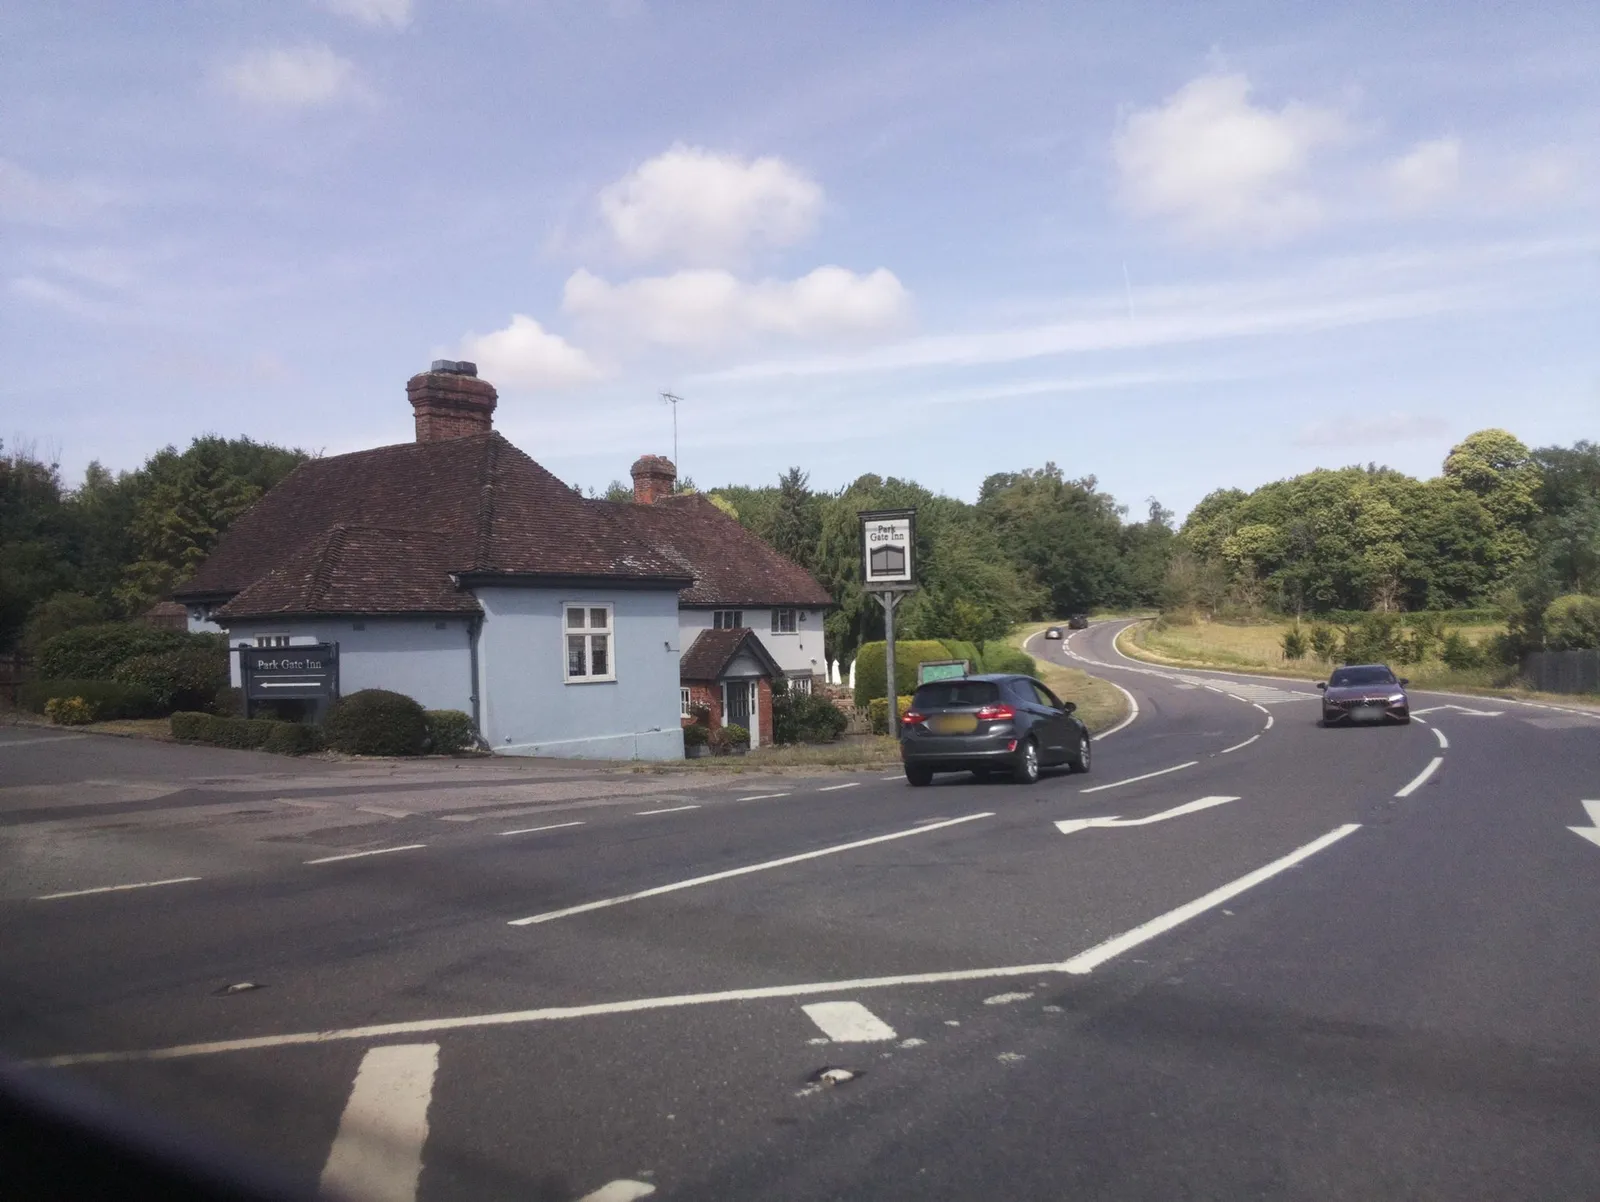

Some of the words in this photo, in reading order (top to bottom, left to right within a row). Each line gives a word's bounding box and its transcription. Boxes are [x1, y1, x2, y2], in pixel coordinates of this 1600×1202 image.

[878, 525, 896, 533] Park
[870, 533, 888, 541] Gate
[258, 660, 278, 669] Park
[281, 660, 303, 669] Gate
[306, 659, 322, 669] Inn
